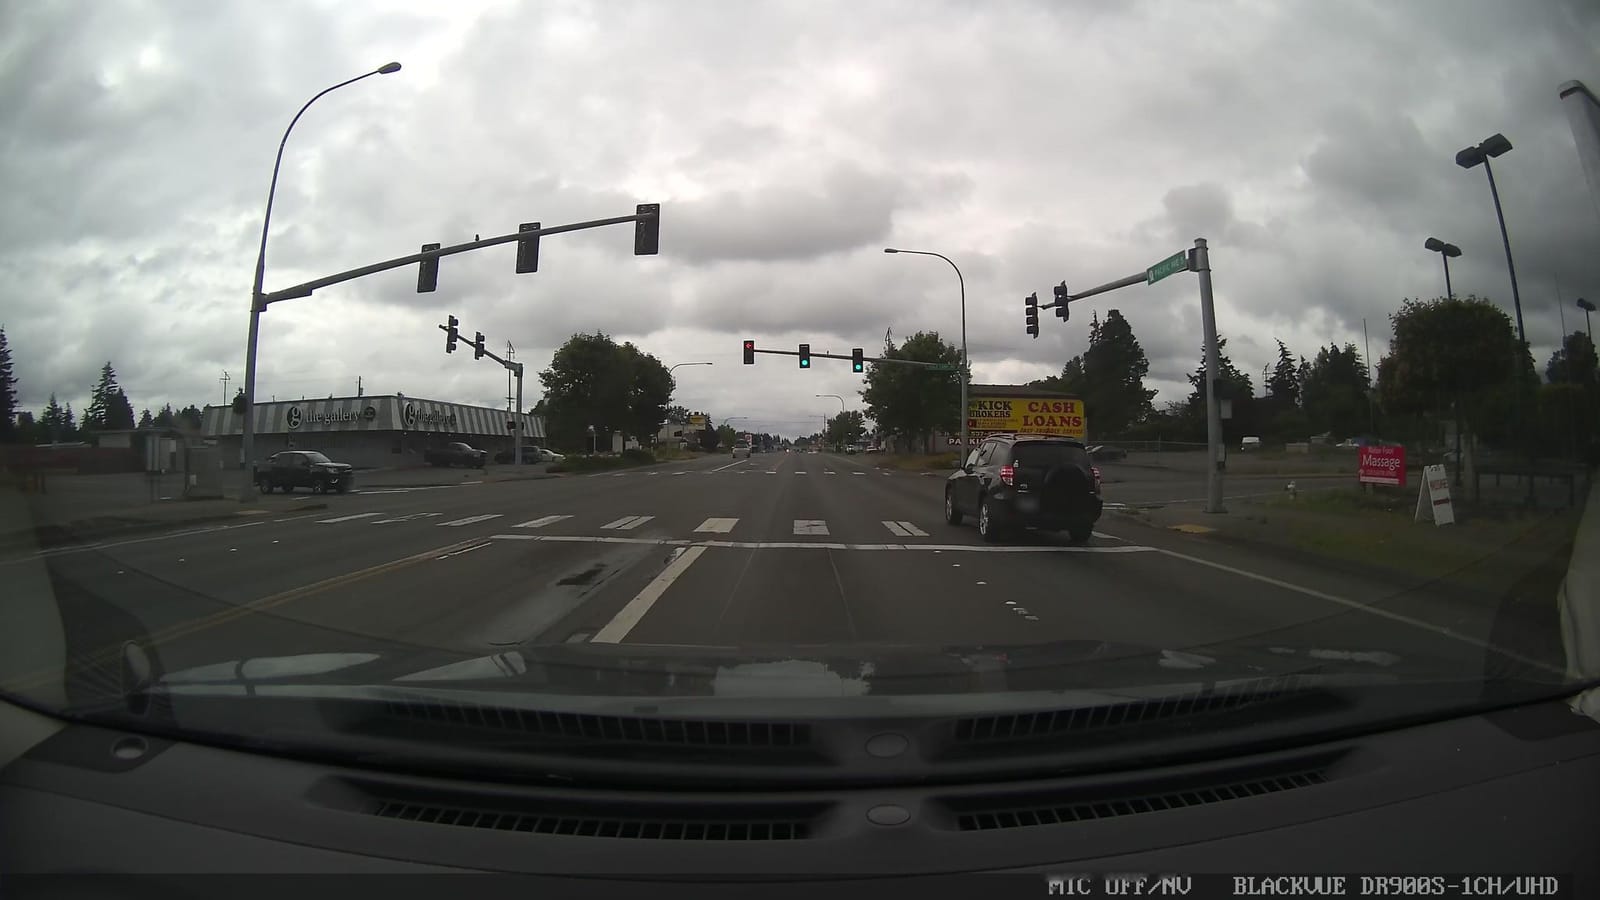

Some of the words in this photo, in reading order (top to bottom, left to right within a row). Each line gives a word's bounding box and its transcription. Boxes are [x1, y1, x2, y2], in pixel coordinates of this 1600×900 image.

[977, 400, 1012, 410] KICK
[1027, 402, 1075, 413] CASH
[306, 409, 322, 423] the
[324, 408, 361, 425] gallery
[1022, 415, 1082, 427] LOANS
[1362, 454, 1401, 471] Massage
